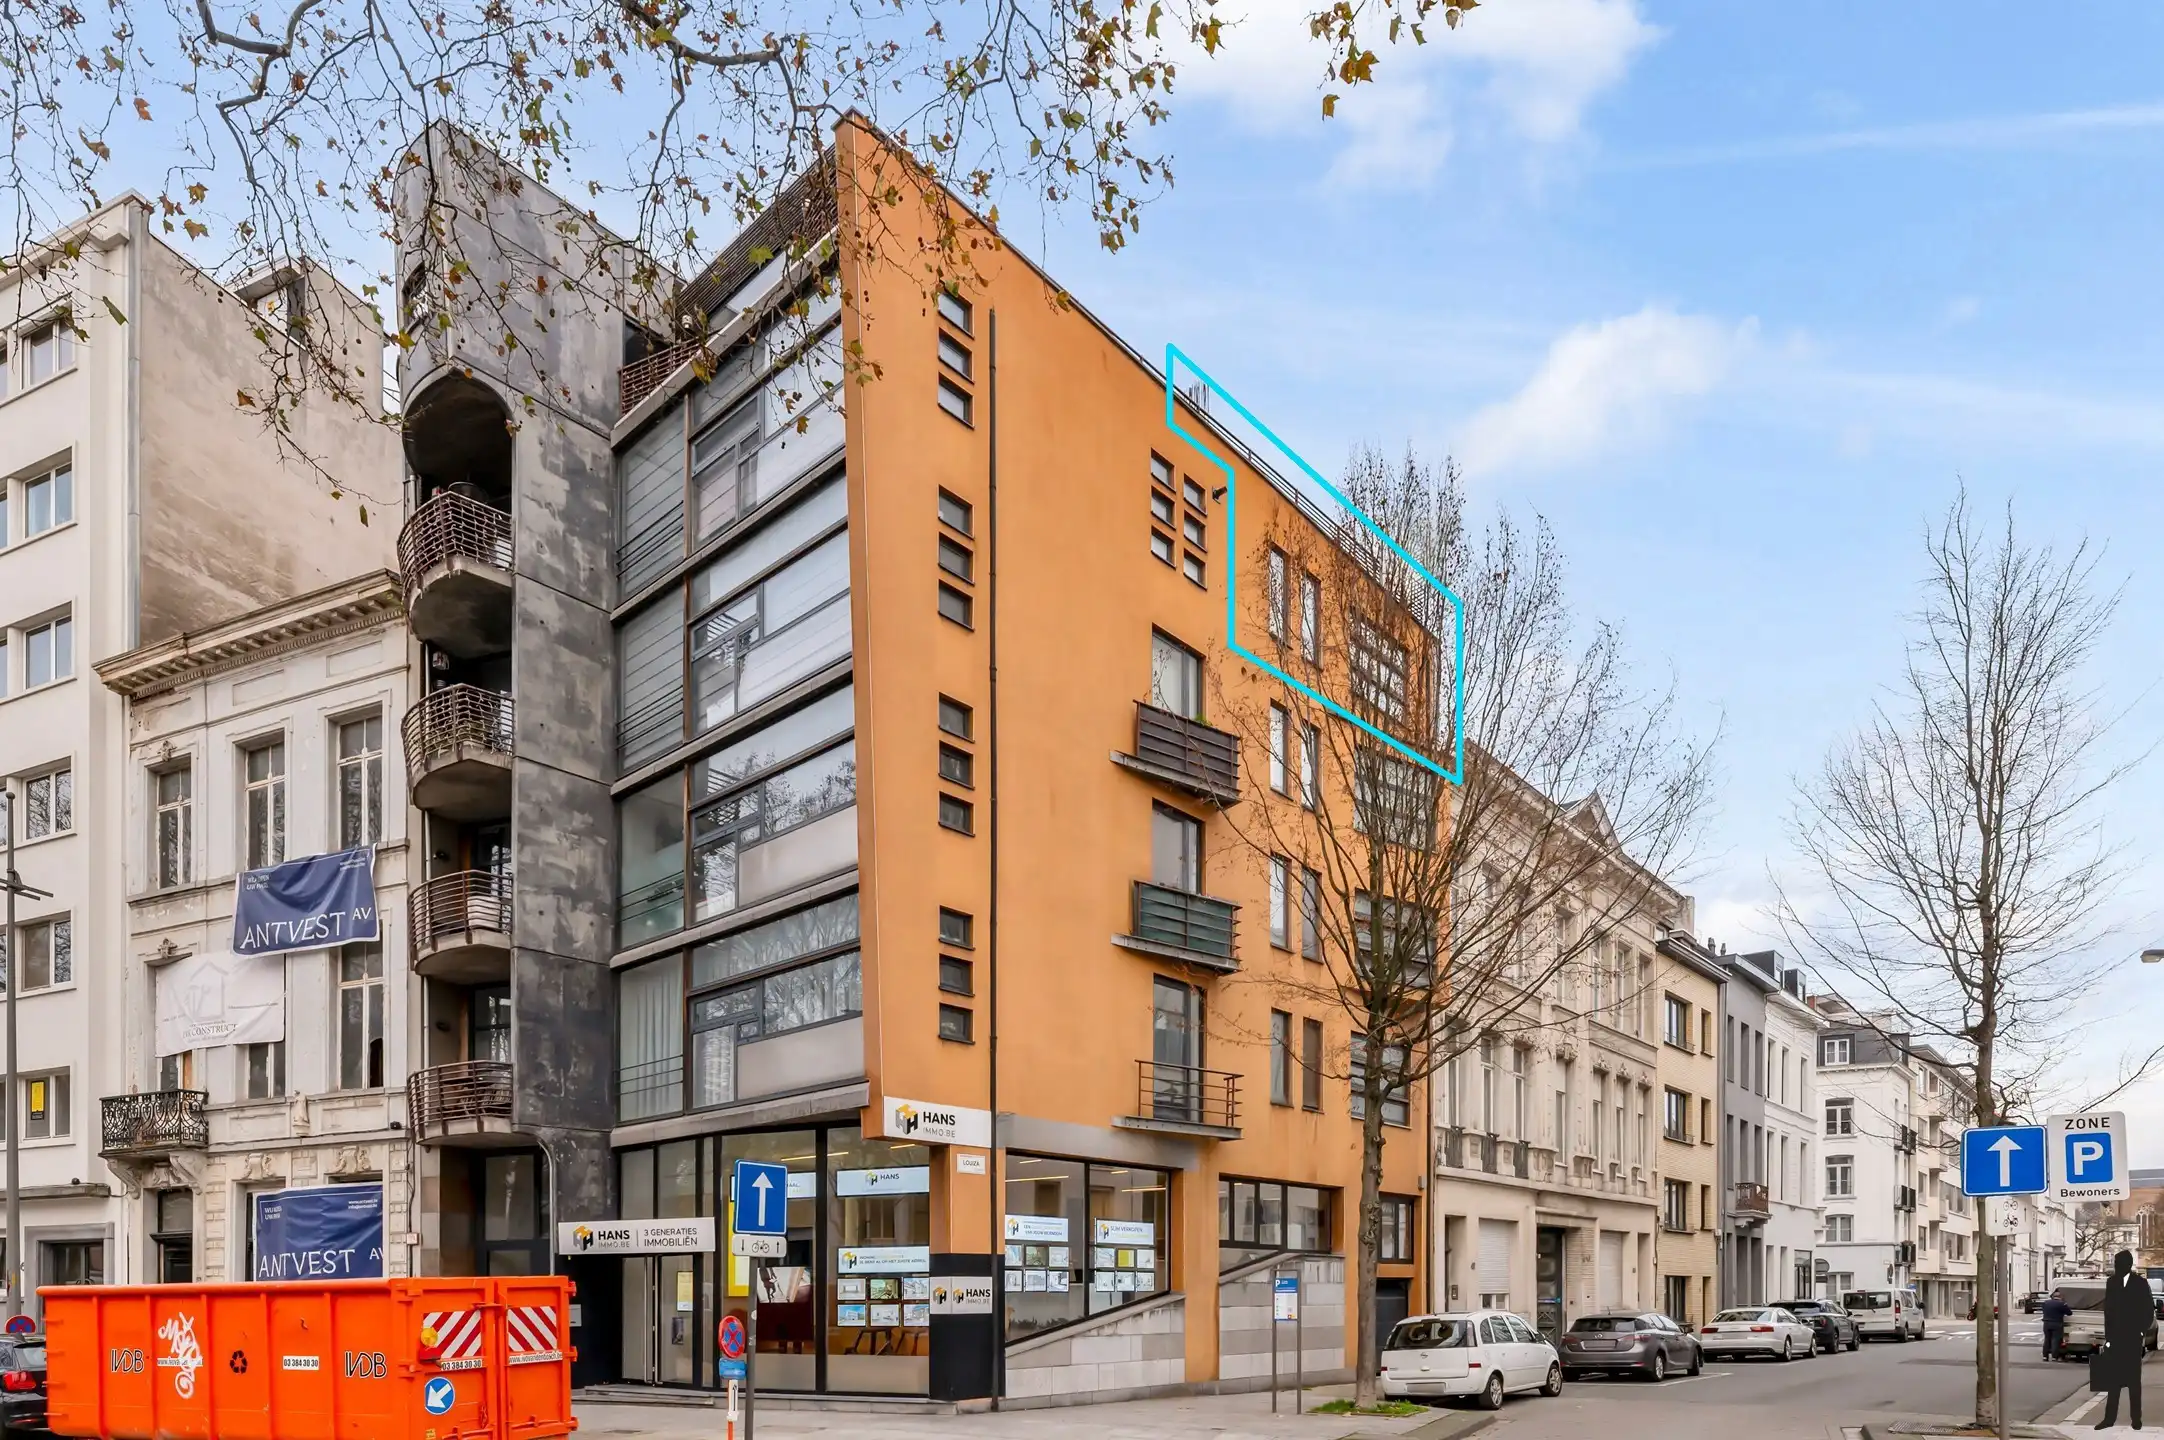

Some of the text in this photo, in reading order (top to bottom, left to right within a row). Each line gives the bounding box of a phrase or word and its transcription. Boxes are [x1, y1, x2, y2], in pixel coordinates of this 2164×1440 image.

[352, 907, 372, 921] AV
[239, 912, 346, 950] ANTVEST
[922, 1111, 956, 1127] HANS
[2064, 1117, 2111, 1130] ZONE
[922, 1126, 956, 1139] IMMO.BE
[2073, 1141, 2104, 1176] P
[2060, 1188, 2121, 1198] Bewoners
[598, 1230, 630, 1241] HANS
[644, 1227, 697, 1237] 3 GENERATIES
[598, 1241, 630, 1249] IMMO.BE
[644, 1236, 698, 1247] IMMOBILIËN
[258, 1249, 356, 1278] ANTVEST
[1275, 1279, 1281, 1287] P
[966, 1288, 991, 1298] HANS
[303, 1359, 310, 1367] 30
[311, 1359, 319, 1368] 30
[442, 1359, 481, 1371] 03 384 30 30
